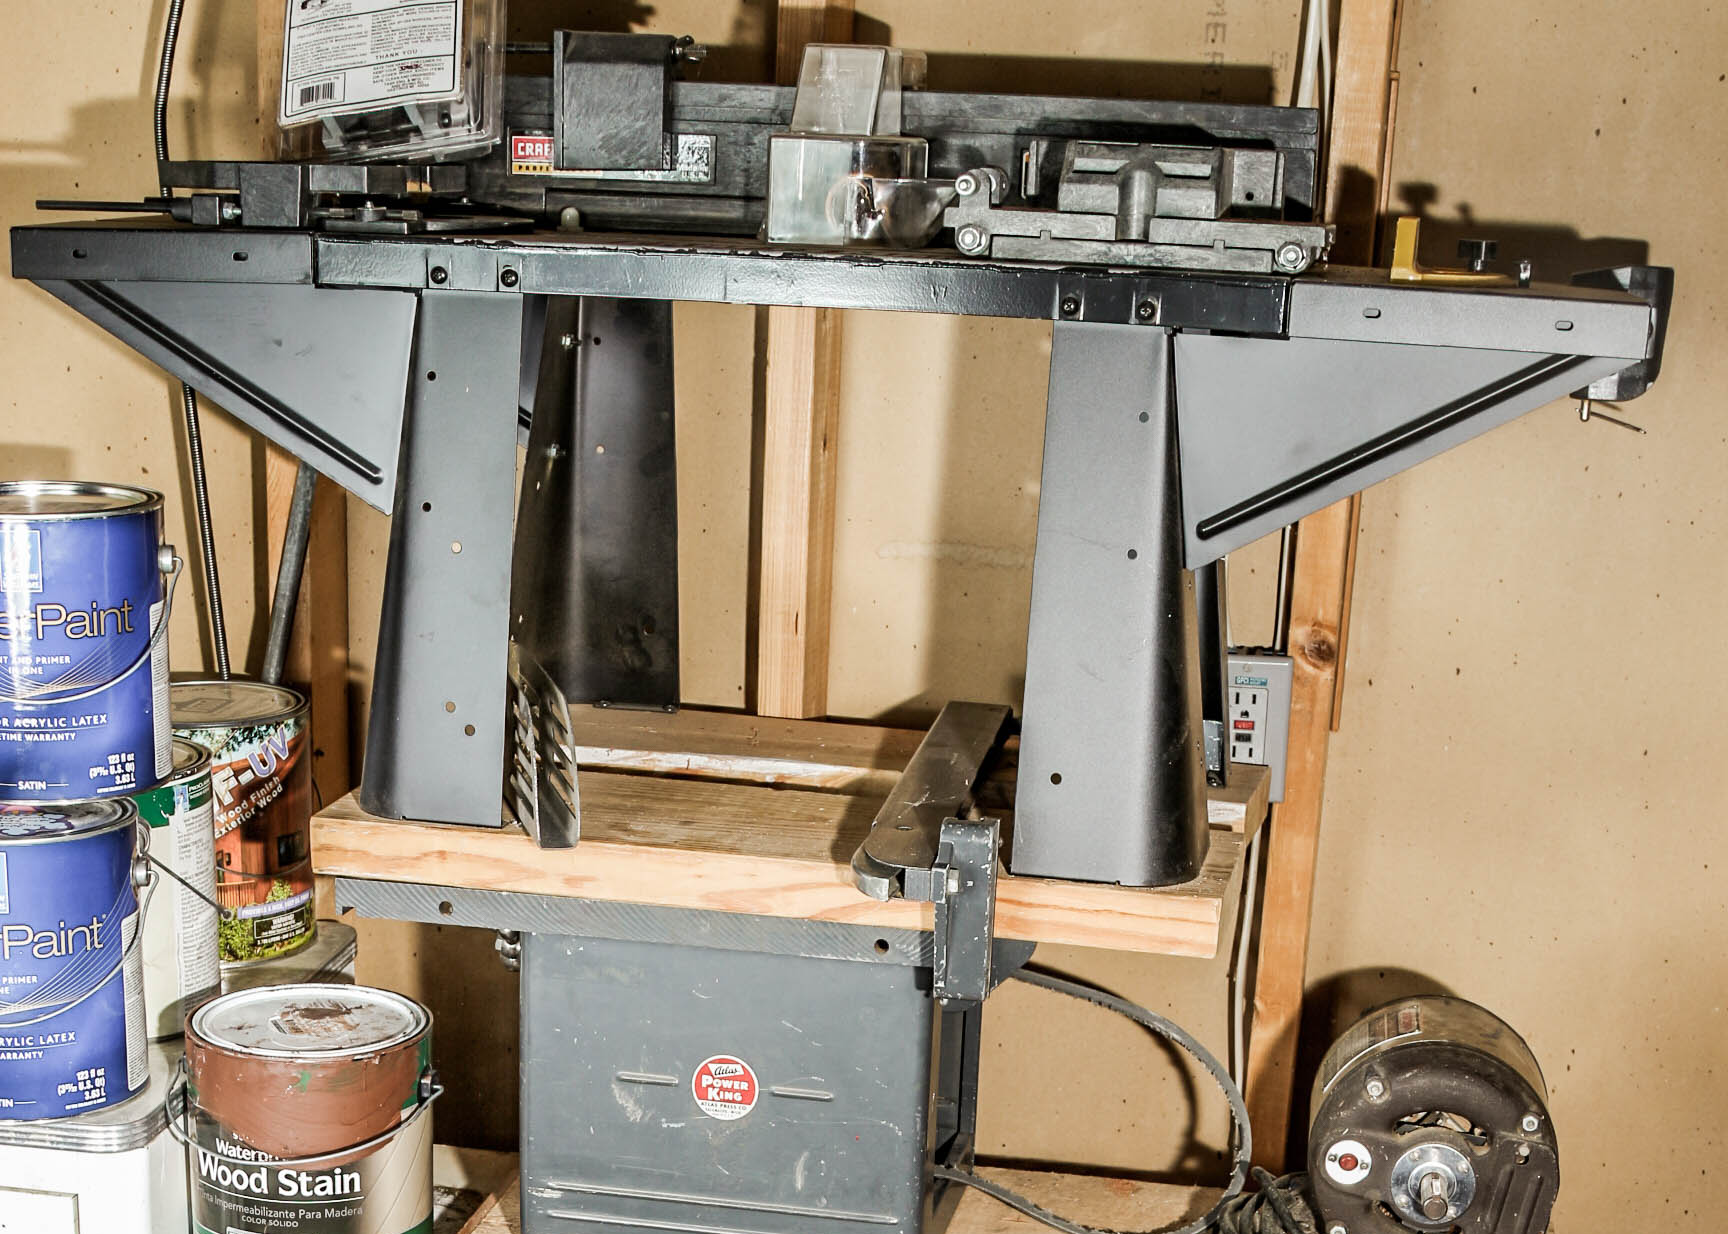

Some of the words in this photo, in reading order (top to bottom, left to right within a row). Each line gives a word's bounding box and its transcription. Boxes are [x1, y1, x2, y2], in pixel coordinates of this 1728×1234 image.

[375, 52, 400, 60] THANK
[36, 656, 71, 664] PRIMER
[23, 666, 43, 675] ONE
[14, 717, 67, 728] ACRYLIC
[71, 714, 107, 727] LATEX
[24, 732, 76, 742] WARRANTY
[18, 781, 47, 791] SATIN
[216, 800, 249, 824] Wood
[250, 776, 281, 802] Finish
[215, 807, 257, 838] Exterior
[257, 784, 283, 809] Wood
[0, 915, 104, 961] Paint
[3, 975, 38, 985] PRIMER
[40, 1031, 76, 1045] LATEX
[76, 1070, 89, 1081] 123
[714, 1066, 738, 1076] Atlas
[84, 1090, 100, 1101] 3.63
[198, 1151, 268, 1194] Wood
[278, 1167, 361, 1197] Stain
[214, 1193, 296, 1219] Impermeabilizante
[298, 1209, 322, 1219] Para
[325, 1205, 363, 1218] Madera
[241, 1214, 267, 1226] COLOR
[268, 1217, 299, 1229] SÓLIDO
